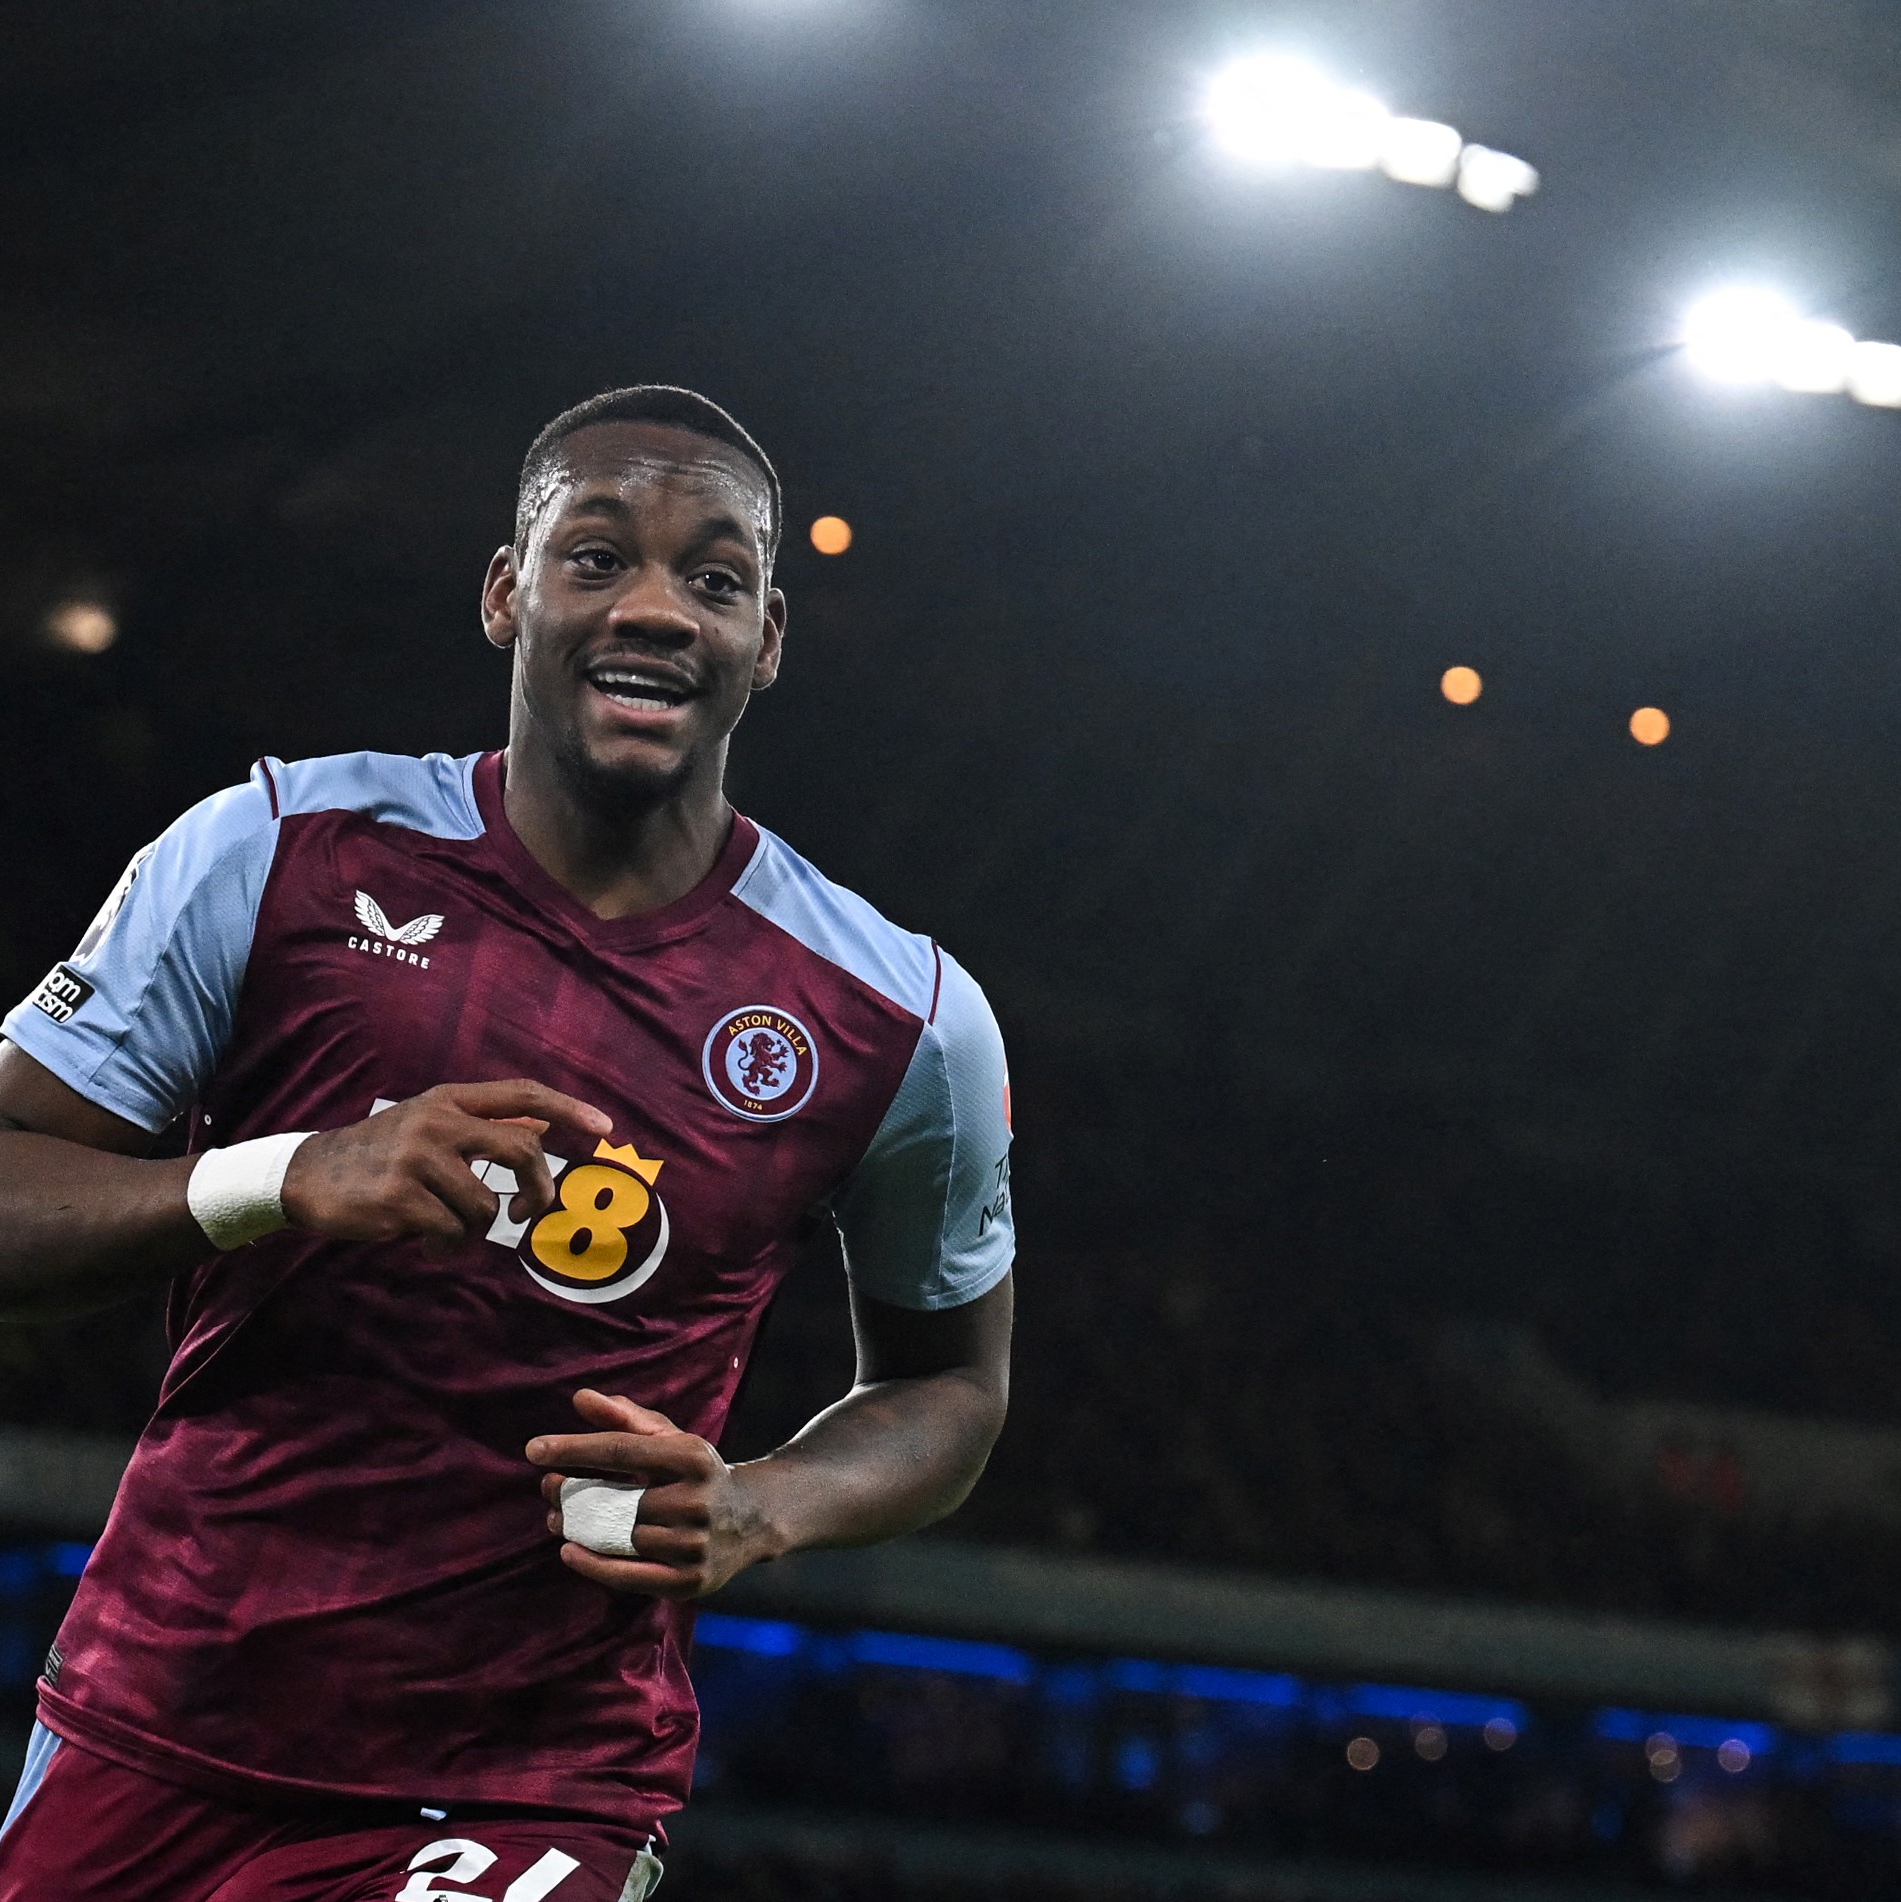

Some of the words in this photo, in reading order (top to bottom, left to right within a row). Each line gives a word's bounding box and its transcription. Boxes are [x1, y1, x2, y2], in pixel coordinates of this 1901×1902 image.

[348, 936, 430, 970] CASTORE
[728, 1015, 772, 1036] ASTON
[776, 1019, 807, 1056] VILLA
[743, 1099, 763, 1111] 1874
